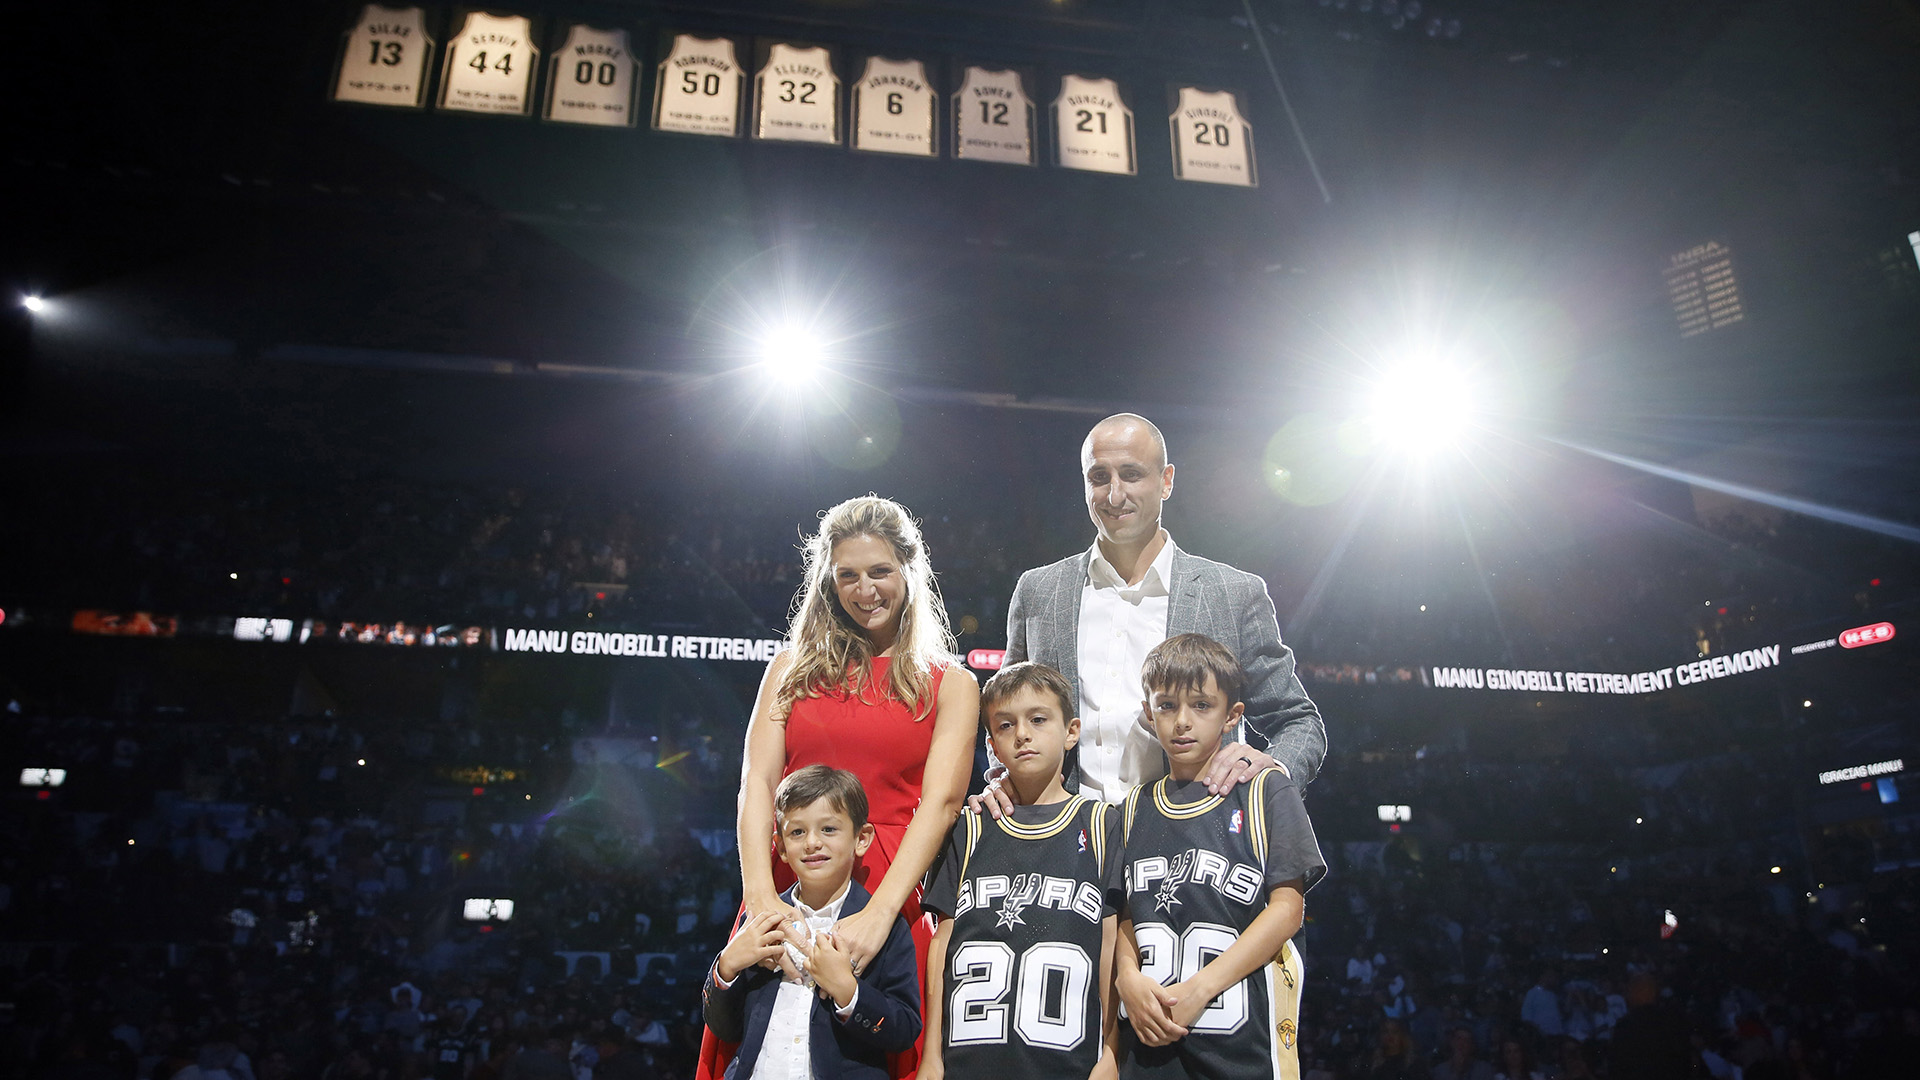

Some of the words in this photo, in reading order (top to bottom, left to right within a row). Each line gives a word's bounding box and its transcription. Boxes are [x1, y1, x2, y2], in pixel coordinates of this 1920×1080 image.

[370, 39, 404, 67] 13
[469, 50, 513, 76] 44
[674, 55, 731, 72] ROBINSON
[576, 61, 617, 86] 00
[681, 71, 720, 96] 50
[774, 64, 824, 79] ELLIOTT
[868, 75, 922, 92] JOHNSON
[779, 80, 817, 105] 32
[887, 92, 904, 115] 6
[973, 86, 1013, 99] BOWEN
[1067, 95, 1114, 109] DUNCAN
[980, 100, 1010, 127] 12
[1076, 109, 1107, 134] 21
[1194, 122, 1230, 147] 20
[504, 627, 568, 653] MANU
[571, 630, 669, 658] GINOBILI
[1791, 640, 1827, 655] PRESENTED
[1432, 666, 1485, 690] MANU
[1486, 668, 1565, 693] GINOBILI
[1566, 667, 1673, 695] RETIREMENT
[1676, 644, 1781, 687] CEREMONY
[1867, 758, 1905, 776] MANU!
[1124, 848, 1265, 911] PURS
[954, 872, 1103, 929] SPURS
[948, 940, 1094, 1052] 20
